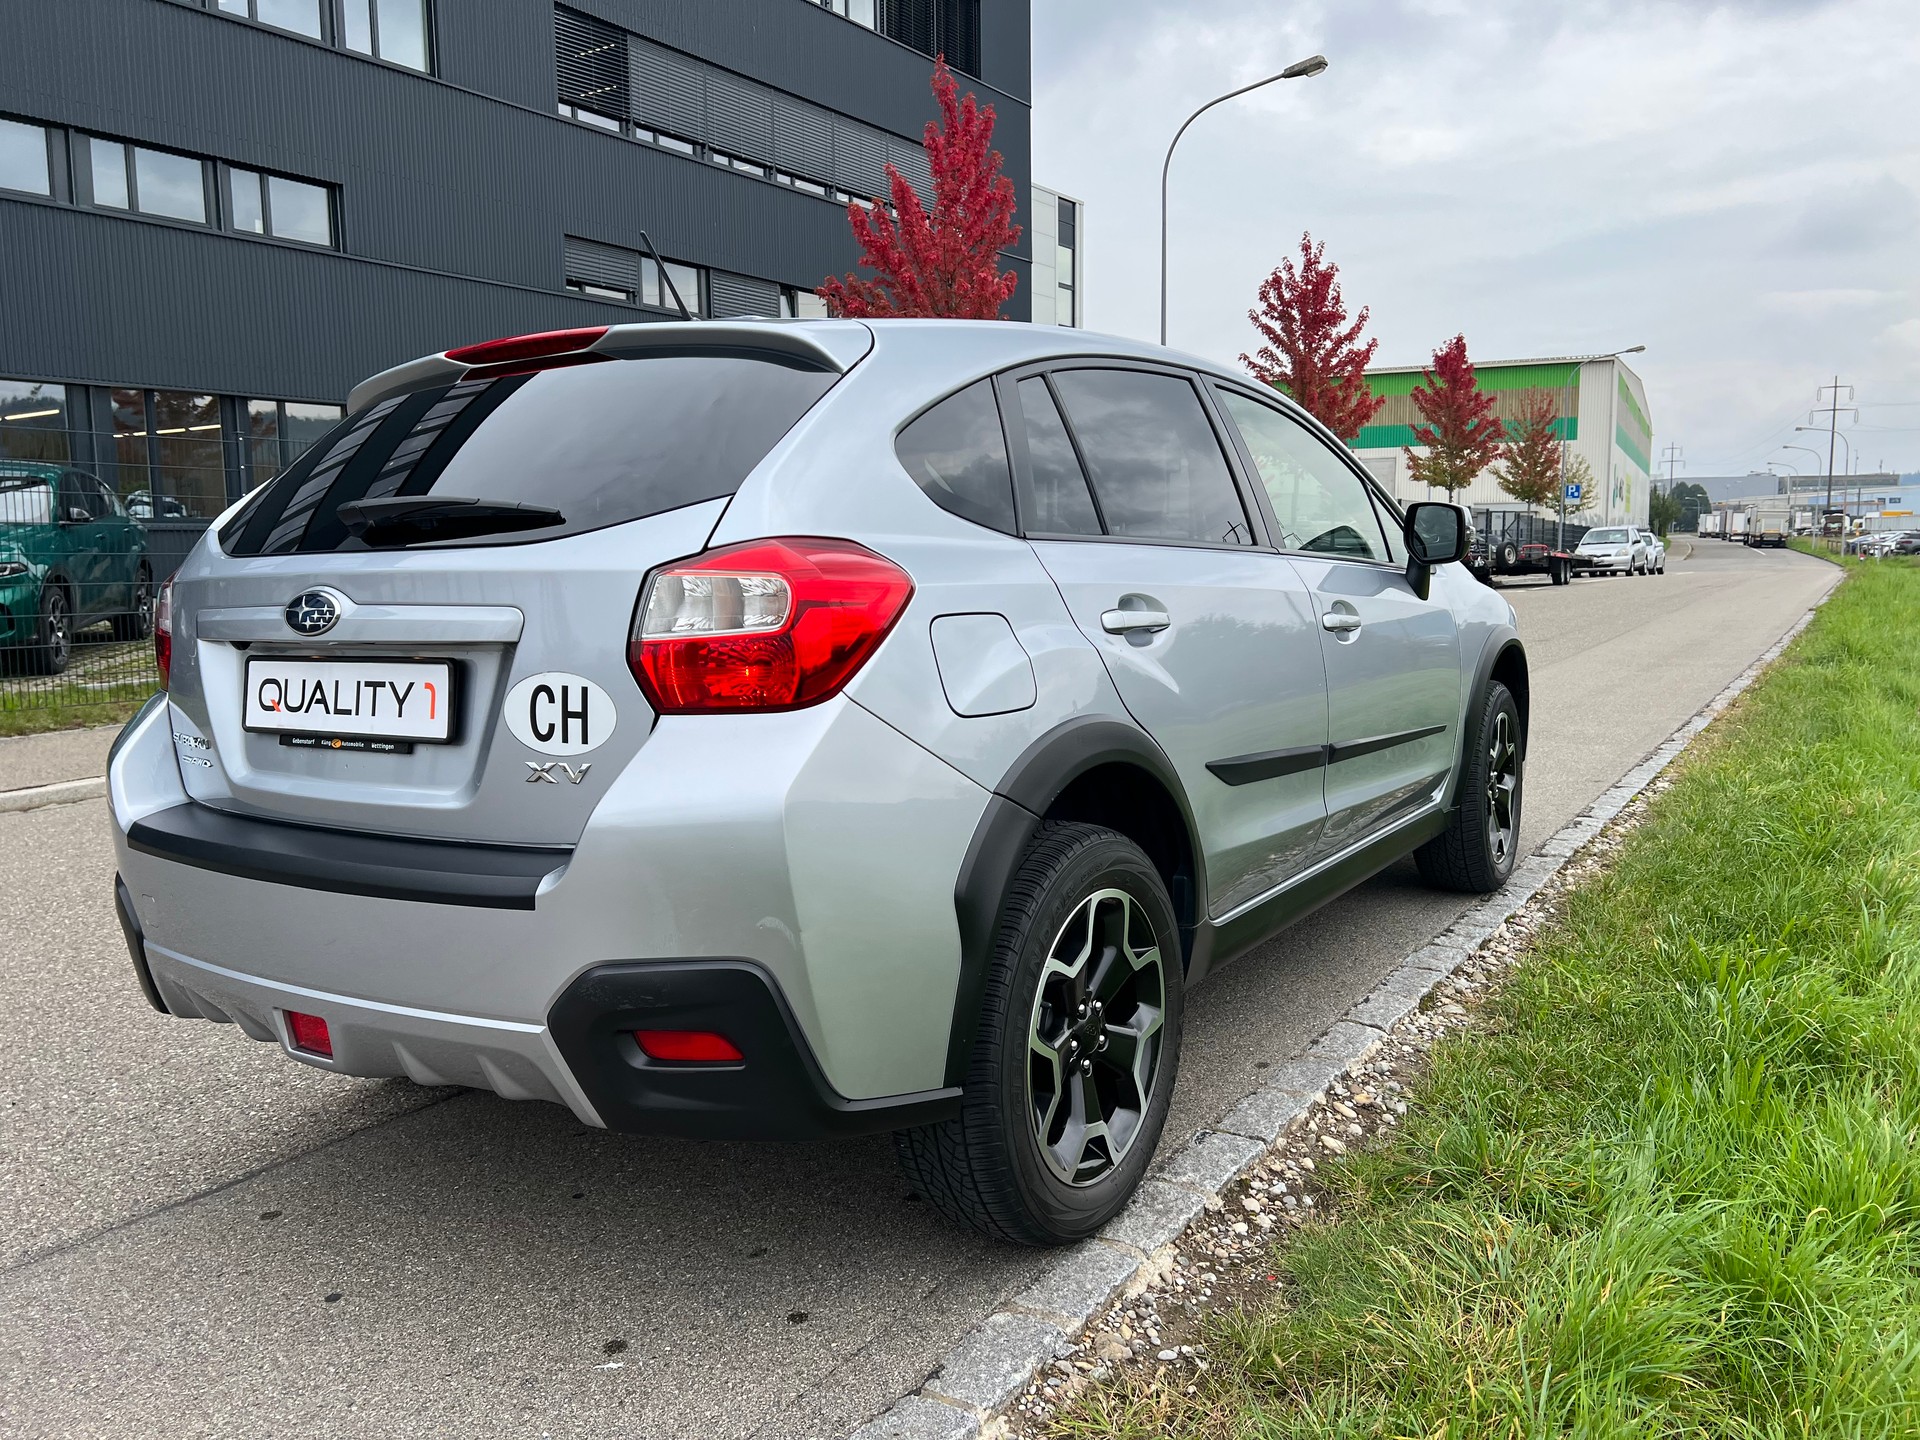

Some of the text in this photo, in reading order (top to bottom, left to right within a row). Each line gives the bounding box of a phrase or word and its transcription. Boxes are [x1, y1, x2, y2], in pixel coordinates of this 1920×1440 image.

[1568, 485, 1576, 496] P
[258, 678, 436, 719] QUALITY 1
[529, 684, 588, 745] CH
[173, 731, 211, 750] SUBARU
[525, 762, 592, 785] XV
